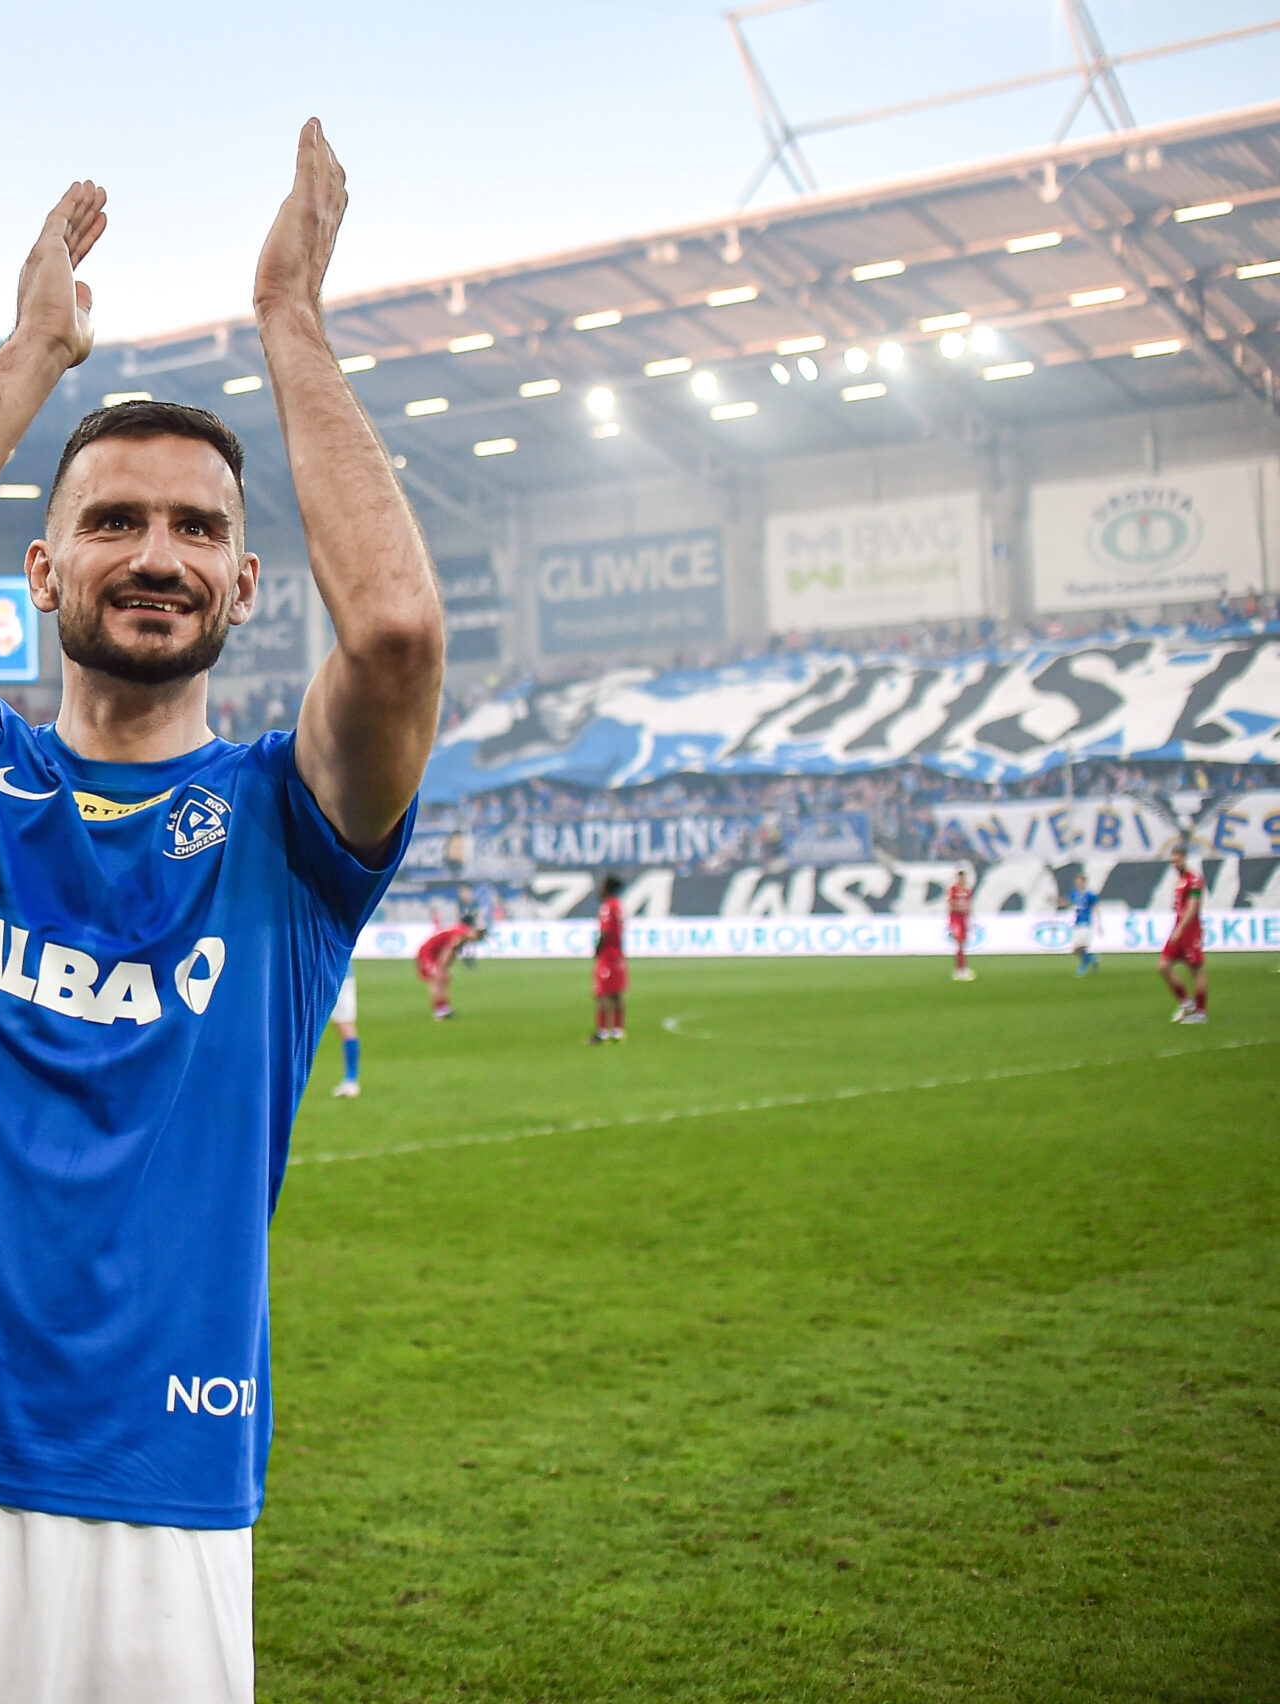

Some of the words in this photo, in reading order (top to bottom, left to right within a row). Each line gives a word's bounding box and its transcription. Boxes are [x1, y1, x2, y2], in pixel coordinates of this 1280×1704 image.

[540, 539, 719, 603] GLIWICE
[204, 797, 227, 815] RUCH
[728, 924, 901, 951] UROLOGII
[1124, 914, 1280, 949] ŚLSKIE
